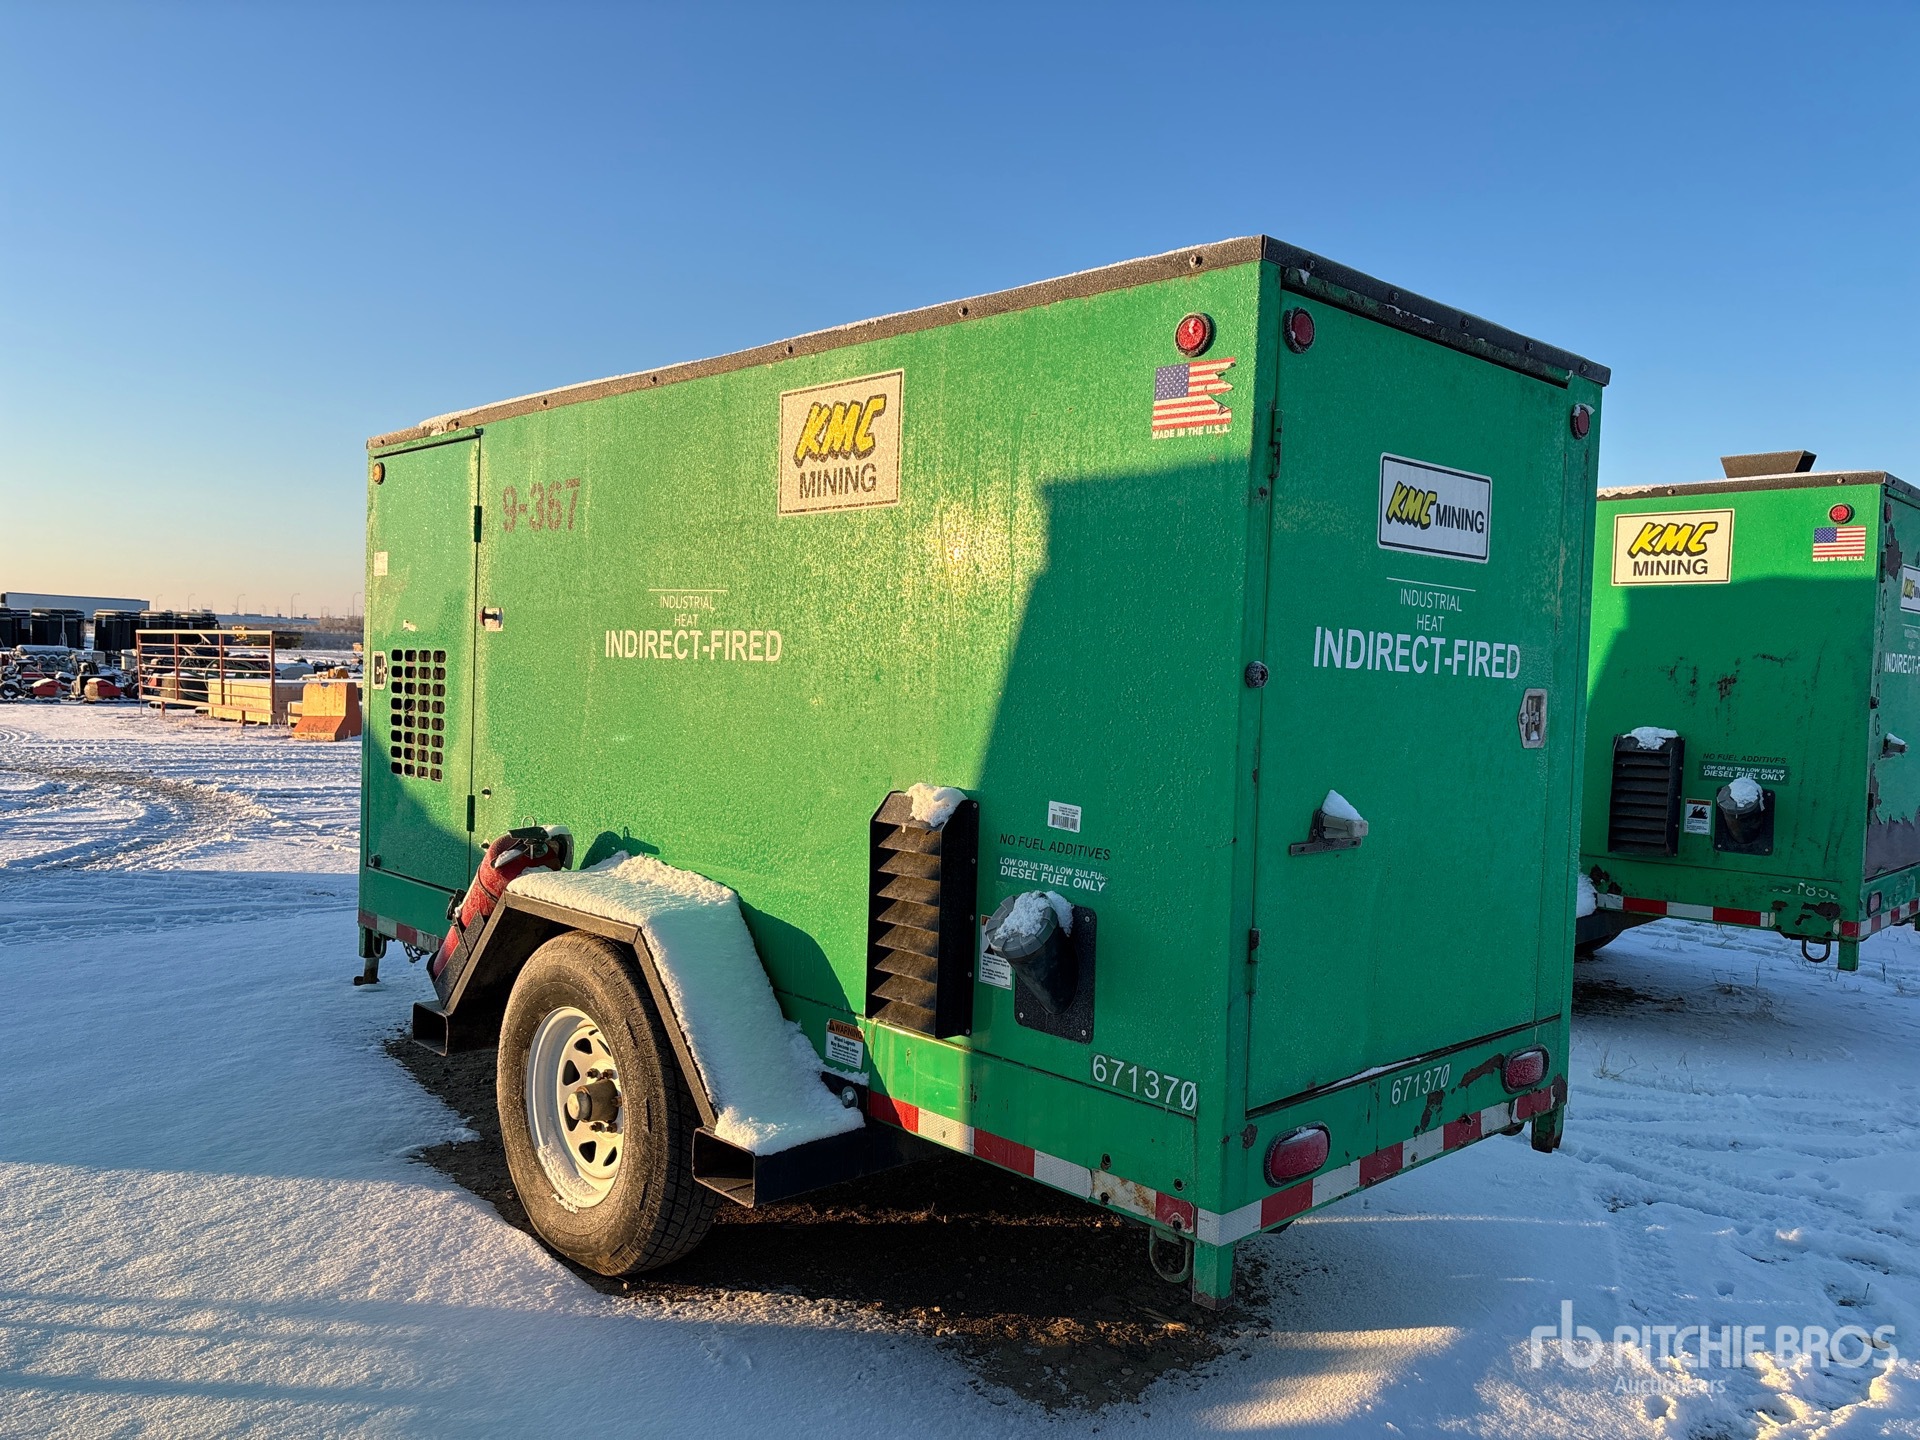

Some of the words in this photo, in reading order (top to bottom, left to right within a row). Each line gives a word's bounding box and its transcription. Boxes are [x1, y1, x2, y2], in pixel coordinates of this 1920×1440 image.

[793, 393, 887, 468] KMC
[1152, 429, 1175, 440] MADE
[1177, 427, 1186, 438] IN
[1187, 426, 1204, 436] THE
[799, 462, 877, 499] MINING
[503, 478, 580, 533] 9-367
[1386, 481, 1437, 530] KMC
[1435, 503, 1484, 534] MINING
[1627, 522, 1718, 559] KMC
[1633, 559, 1708, 576] MINING
[660, 595, 715, 610] INDUSTRIAL
[1400, 588, 1462, 612] INDUSTRIAL
[674, 613, 698, 627] HEAT
[1416, 613, 1444, 632] HEAT
[605, 629, 782, 662] INDIRECT-FIRED
[1313, 626, 1521, 679] INDIRECT-FIRED
[1703, 752, 1715, 760] NO
[1718, 753, 1737, 761] FUEL
[1704, 769, 1733, 778] DIESEL
[1736, 771, 1758, 780] FUEL
[1761, 773, 1785, 781] ONLY
[999, 833, 1016, 846] NO
[1018, 836, 1046, 851] FUEL
[1049, 841, 1111, 861] ADDITIVES
[1000, 857, 1017, 867] LOW
[1018, 859, 1029, 869] OR
[1030, 862, 1054, 873] ULTRA
[1055, 865, 1074, 876] LOW
[1000, 866, 1038, 881] DIESEL
[1041, 872, 1069, 887] FUEL
[1073, 878, 1106, 892] ONLY
[1093, 1054, 1197, 1111] 671370
[1392, 1063, 1450, 1105] 671370
